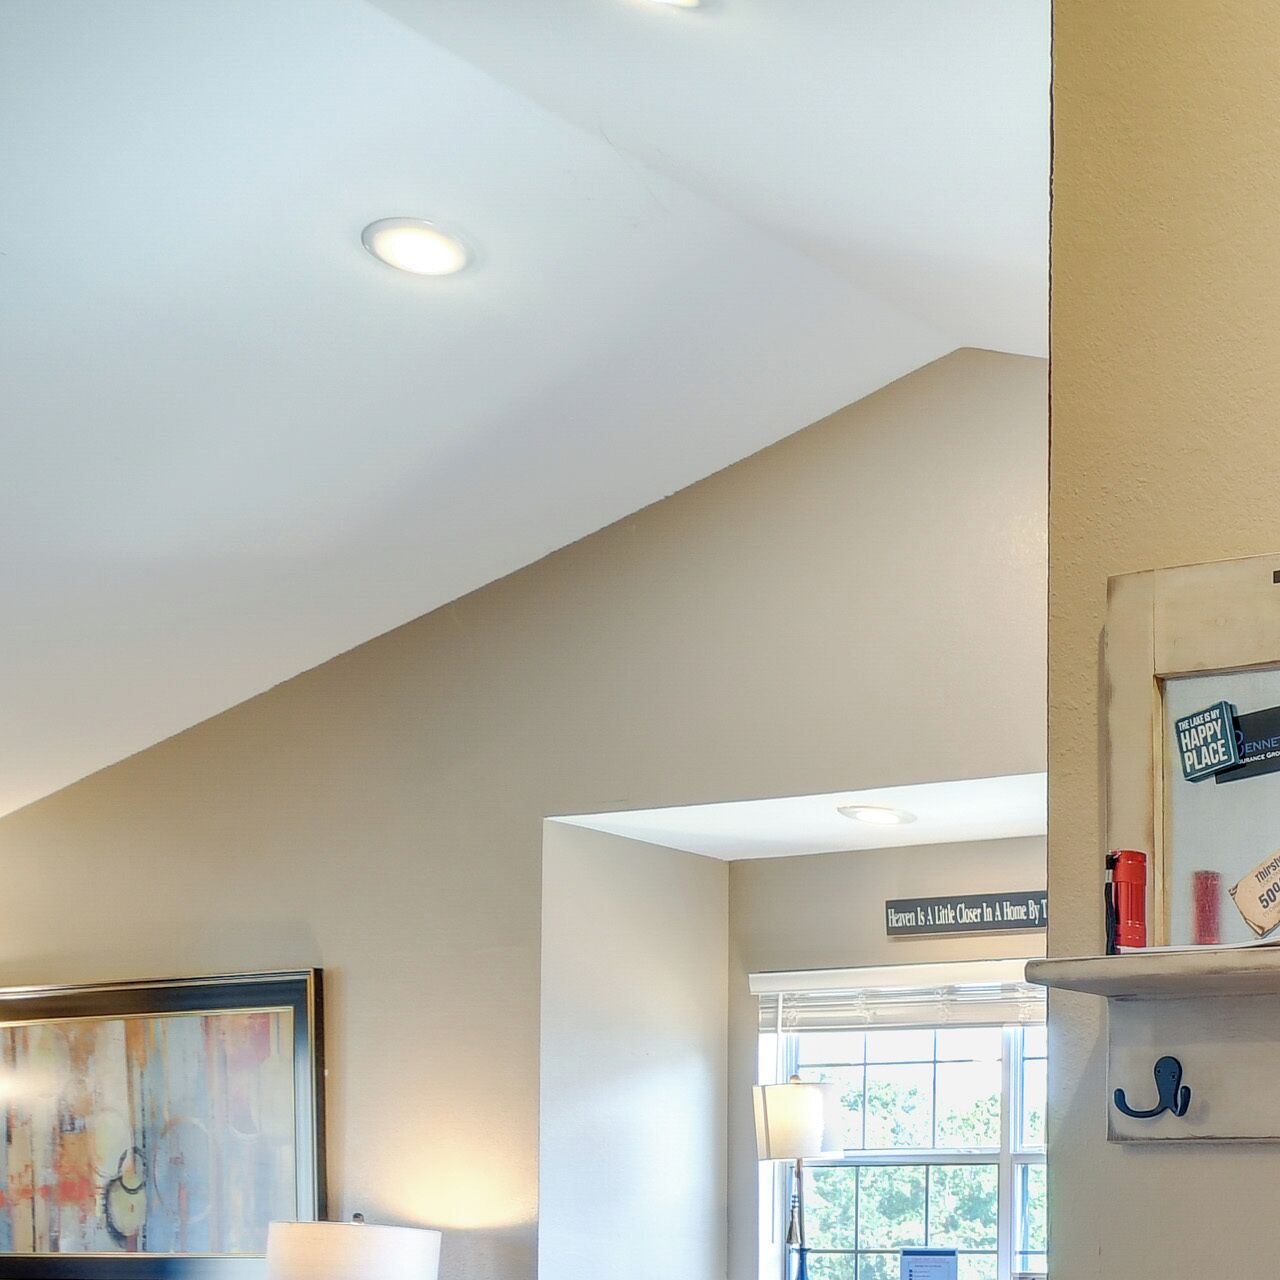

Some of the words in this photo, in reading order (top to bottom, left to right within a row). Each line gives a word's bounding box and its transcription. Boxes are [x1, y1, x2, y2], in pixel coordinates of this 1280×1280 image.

[1178, 719, 1190, 731] THE
[1190, 713, 1205, 728] LAKE
[1204, 712, 1211, 723] IS
[1210, 708, 1220, 720] MY
[1180, 719, 1222, 752] HAPPY
[1184, 740, 1228, 773] PLACE
[1239, 754, 1266, 764] URANCE
[888, 909, 916, 927] Heaven
[917, 907, 925, 926] Is
[926, 906, 933, 925] A
[934, 904, 955, 925] Little
[956, 903, 981, 925] Closer
[982, 902, 993, 922] In
[994, 902, 1002, 921] A
[1003, 901, 1027, 921] Home
[1028, 899, 1040, 925] By
